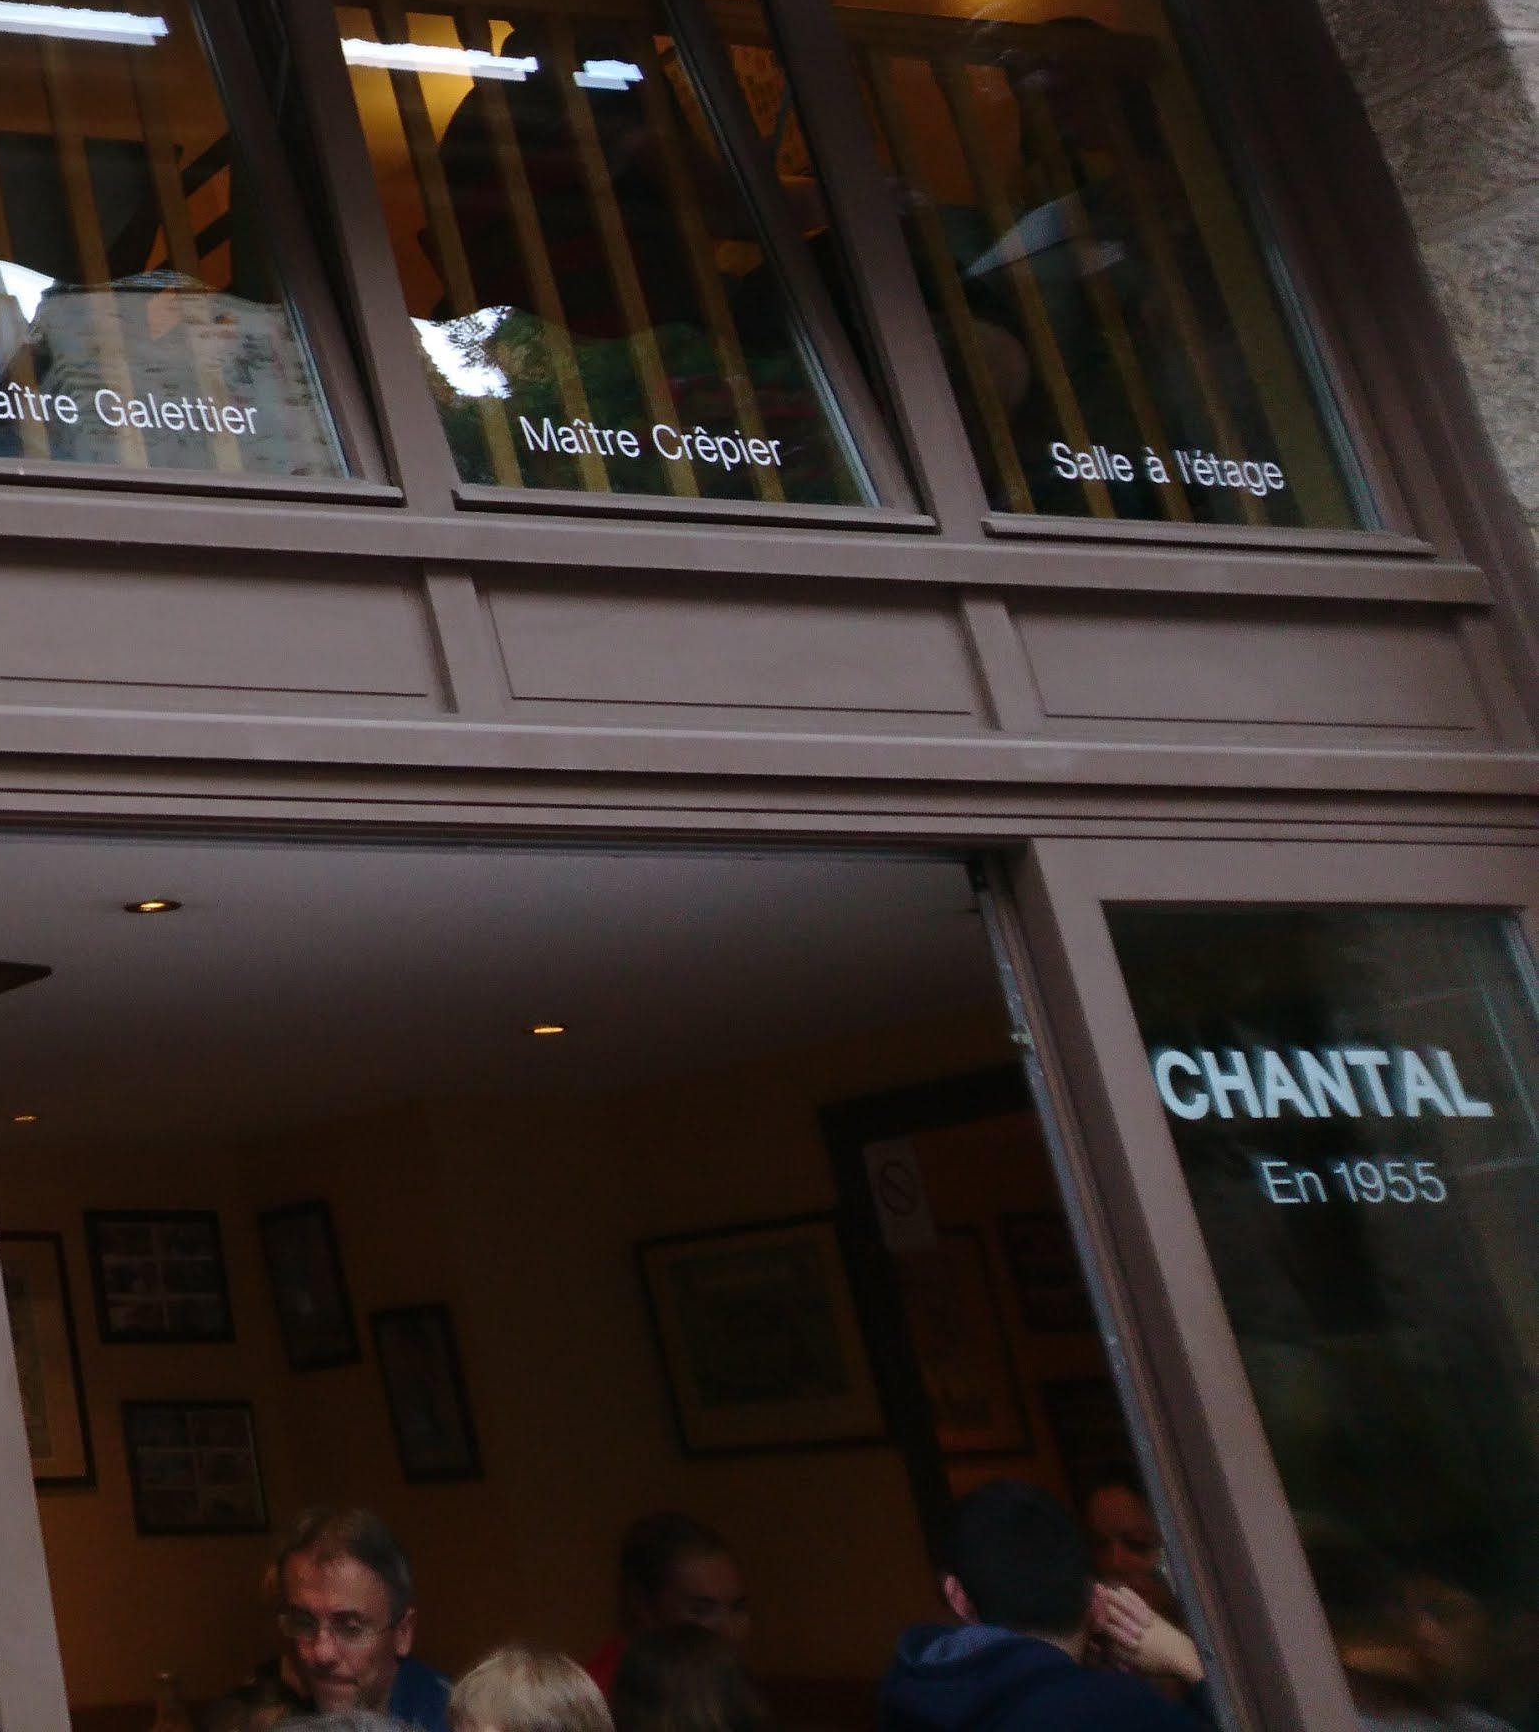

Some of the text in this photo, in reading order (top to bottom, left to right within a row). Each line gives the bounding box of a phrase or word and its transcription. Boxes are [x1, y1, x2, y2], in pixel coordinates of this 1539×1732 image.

[94, 386, 258, 437] Galettier
[518, 416, 782, 473] Maître Crêpier
[1050, 441, 1284, 497] Salle à l'étage
[1153, 1048, 1494, 1121] CHANTAL
[1259, 1160, 1448, 1205] En 1955
